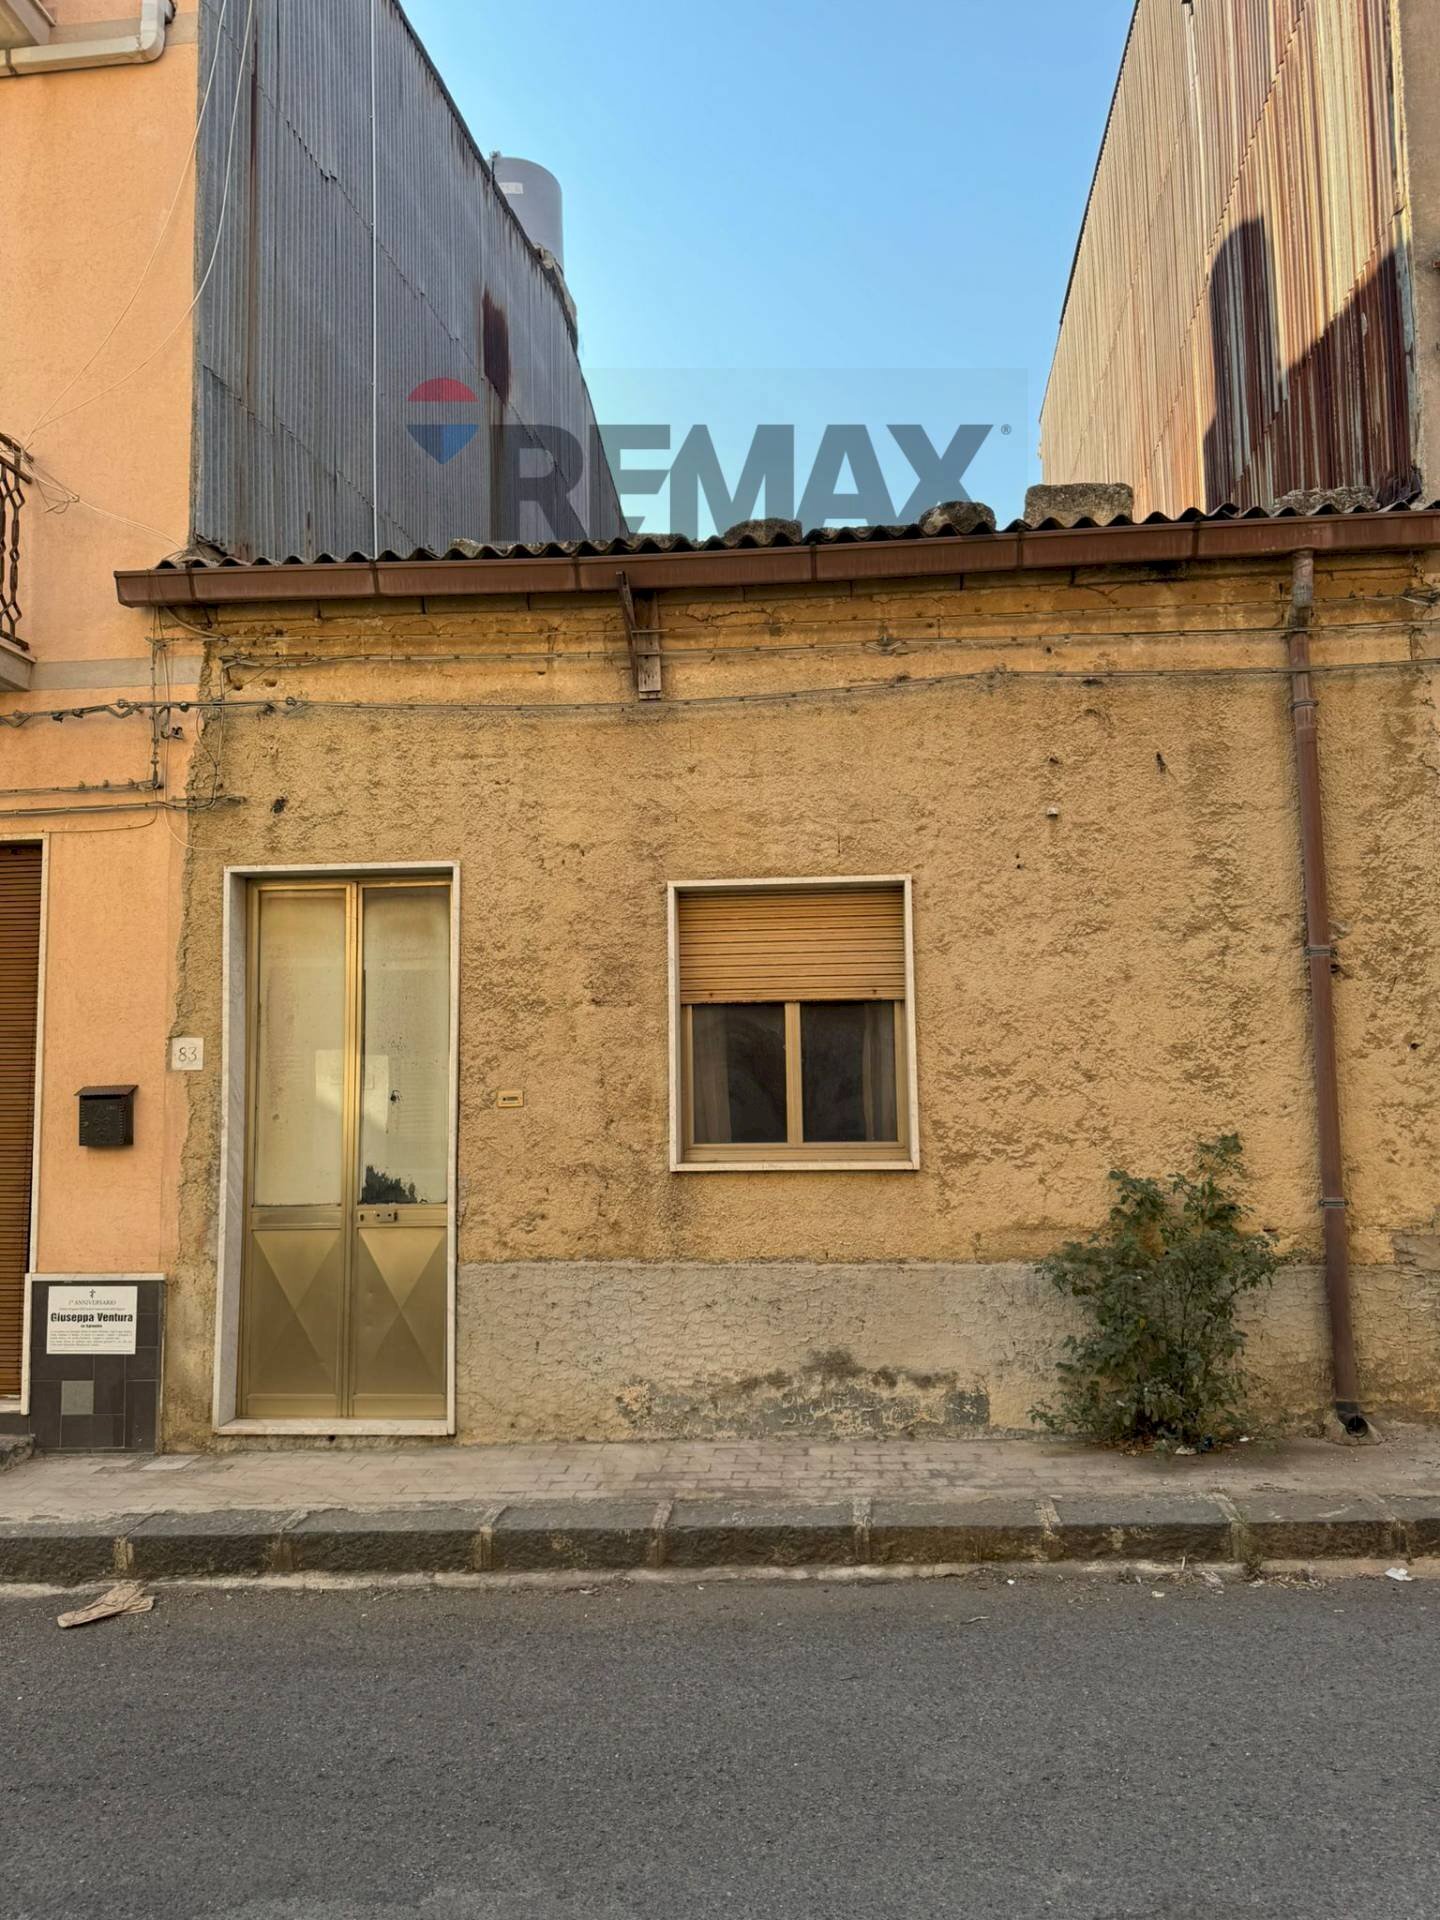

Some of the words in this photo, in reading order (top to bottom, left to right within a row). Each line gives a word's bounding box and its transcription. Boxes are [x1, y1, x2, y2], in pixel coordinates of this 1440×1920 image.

[179, 1047, 197, 1062] 83
[50, 1312, 95, 1323] Giuseppa
[97, 1312, 133, 1322] Ventura
